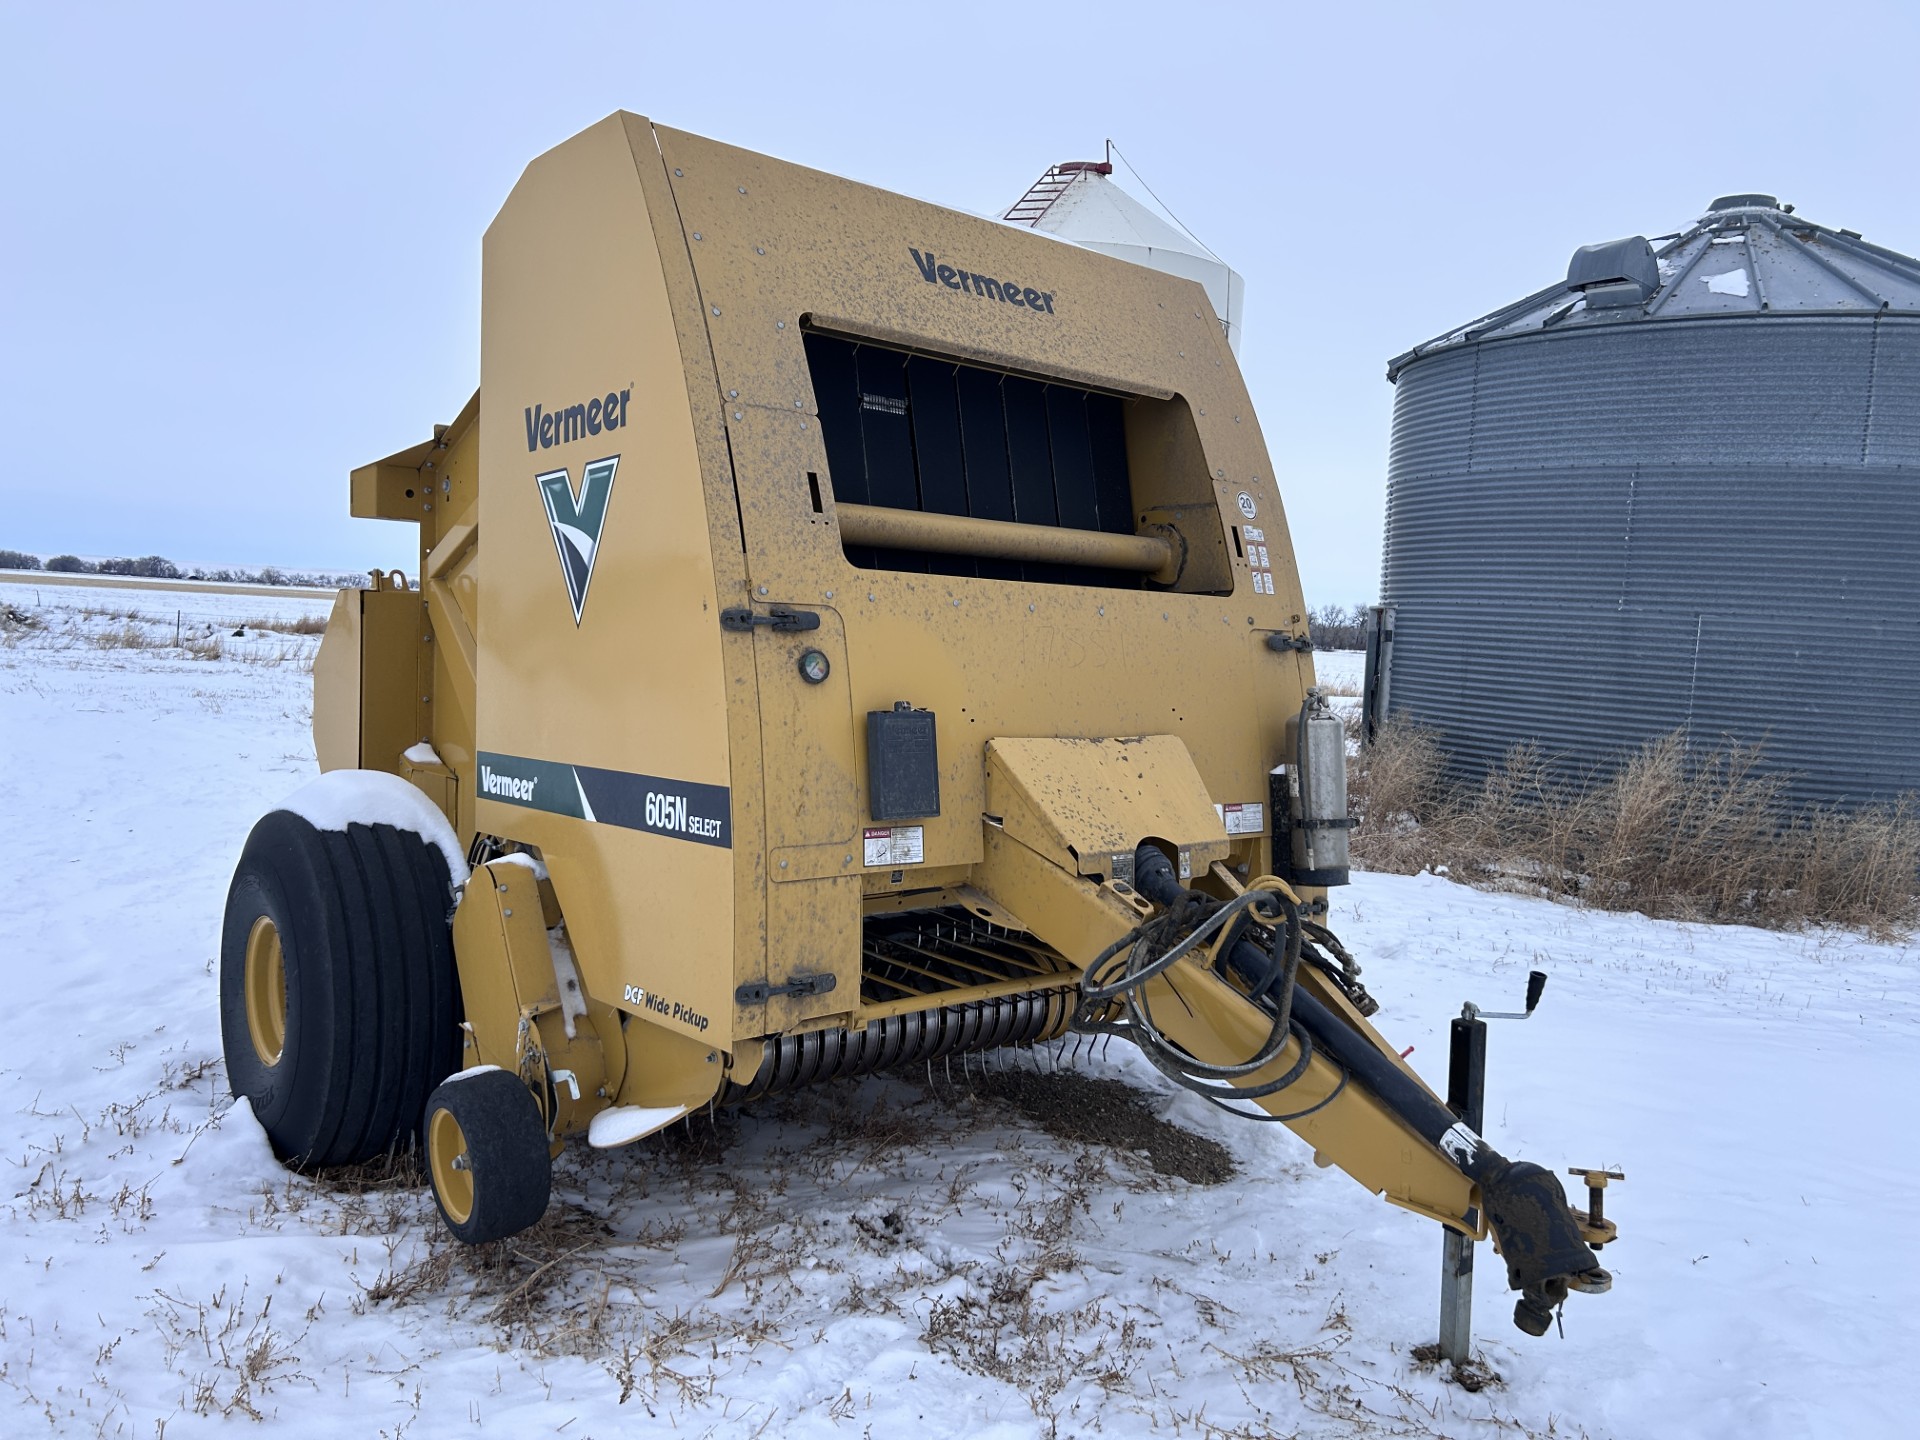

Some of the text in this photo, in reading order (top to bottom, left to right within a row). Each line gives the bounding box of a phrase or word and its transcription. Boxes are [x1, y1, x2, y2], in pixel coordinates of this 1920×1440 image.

[908, 247, 1054, 314] Vermeer
[525, 388, 631, 452] Vermeer
[1240, 496, 1252, 509] 20
[481, 765, 534, 801] Vermeer
[645, 791, 722, 839] 605N SELECT
[624, 983, 709, 1032] DCF Wide Pickup
